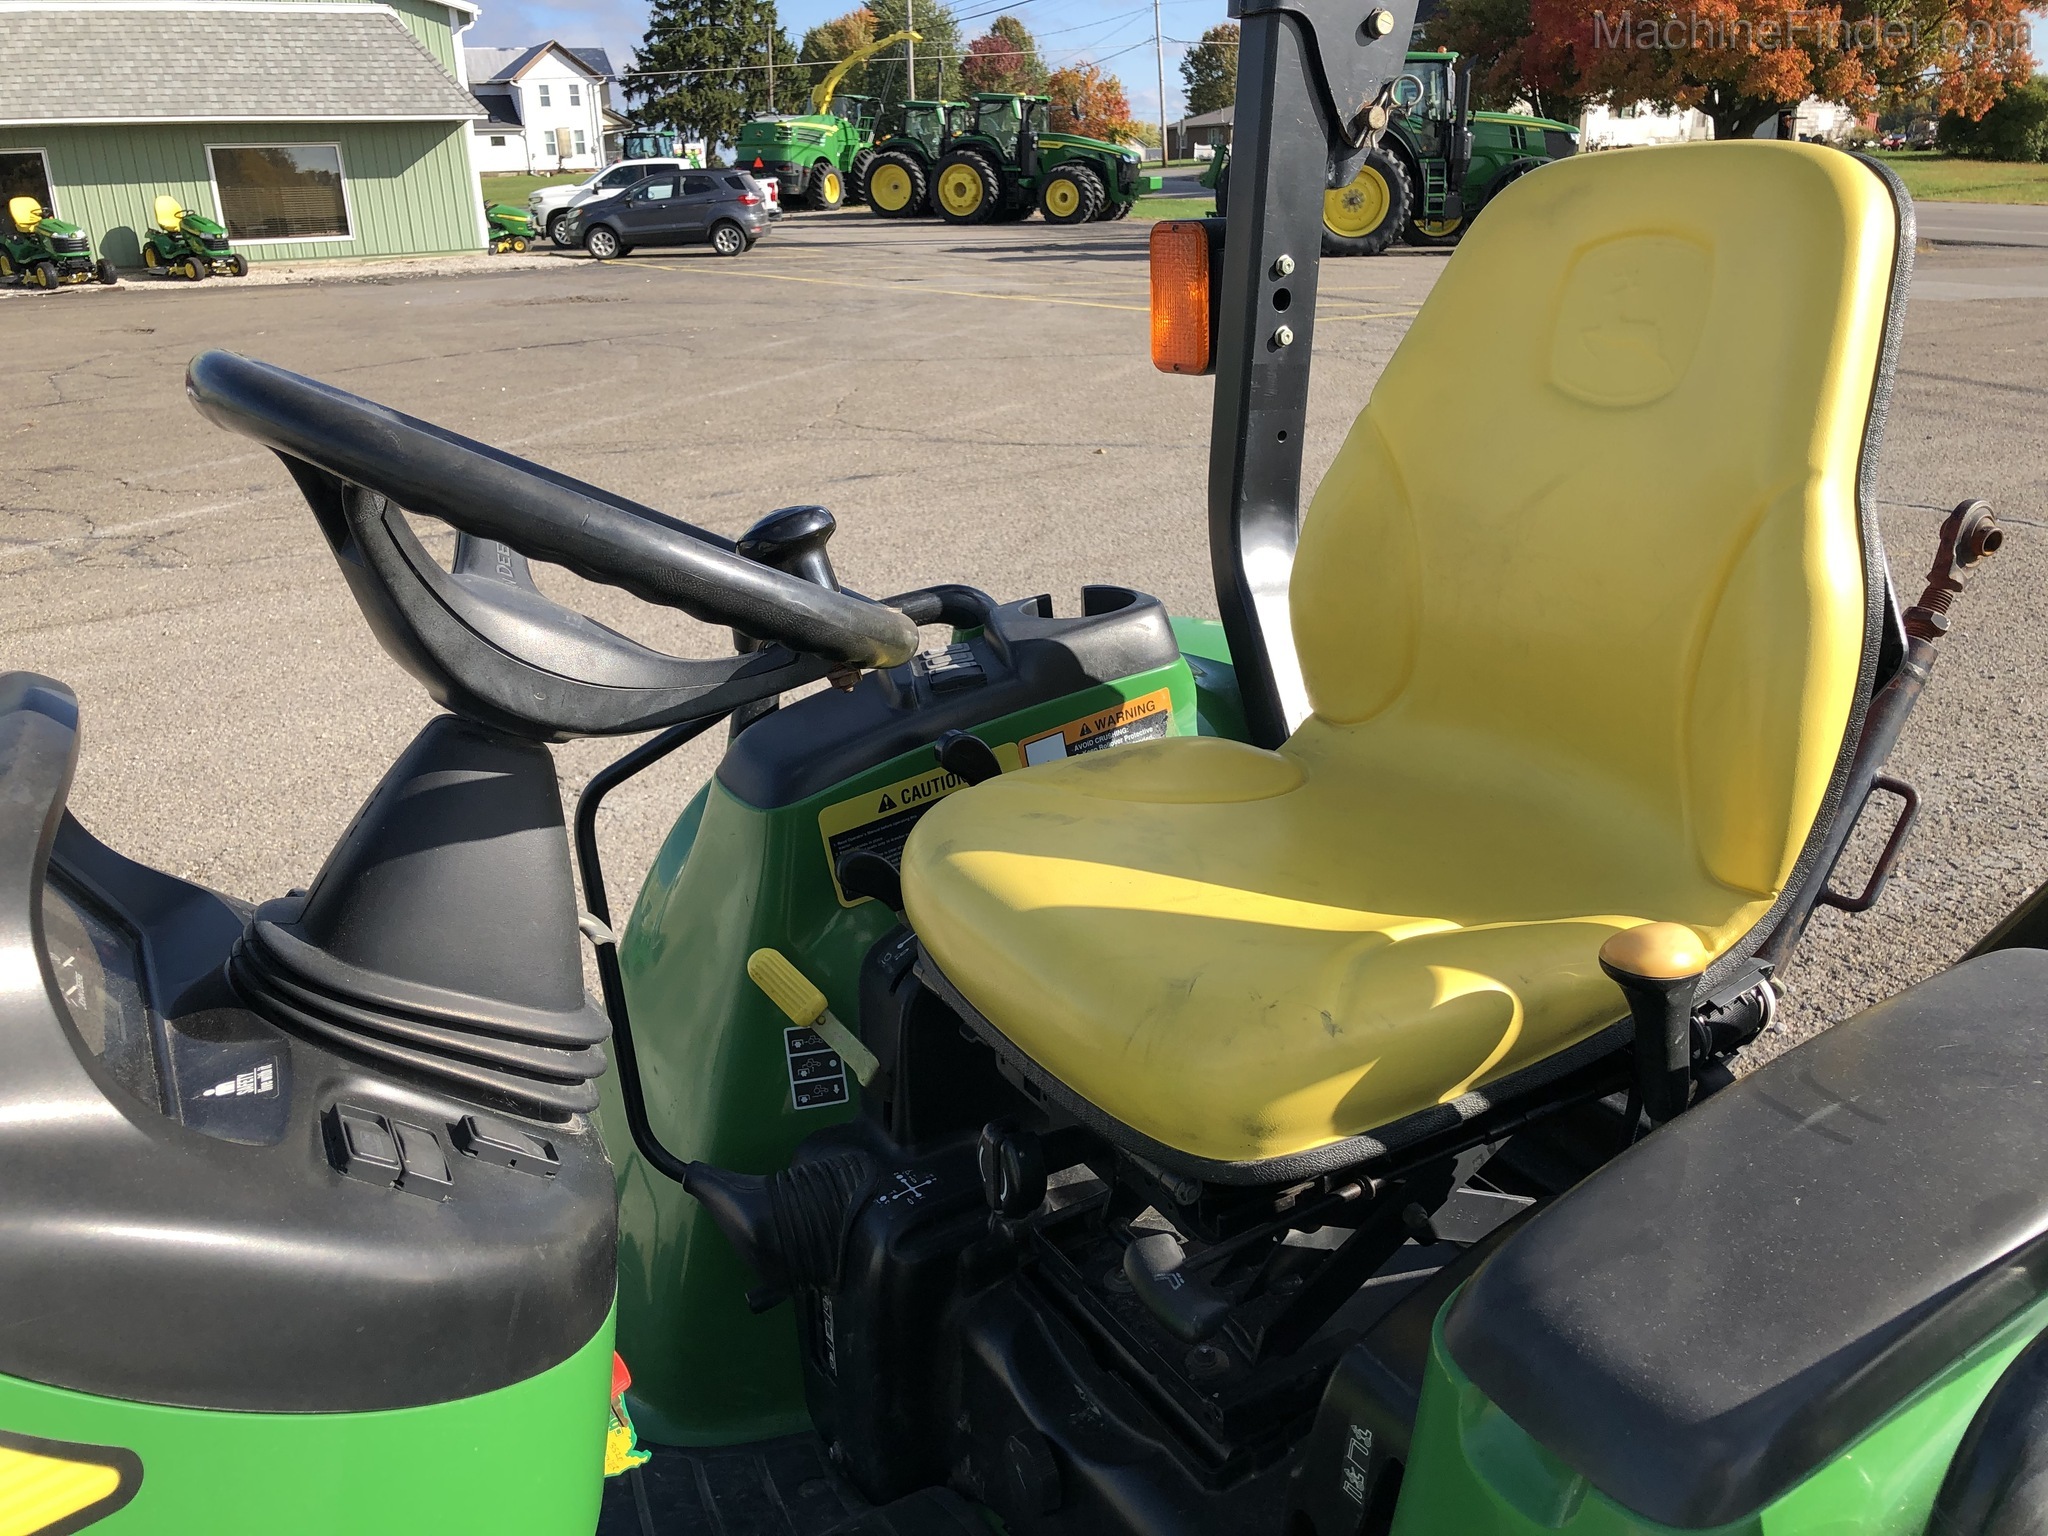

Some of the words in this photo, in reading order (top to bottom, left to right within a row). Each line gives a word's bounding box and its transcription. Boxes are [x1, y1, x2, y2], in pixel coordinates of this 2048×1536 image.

[1095, 700, 1156, 730] WARNING
[1074, 739, 1094, 752] AVOID
[1094, 727, 1130, 744] CRUSHING:
[1123, 726, 1154, 742] Protective
